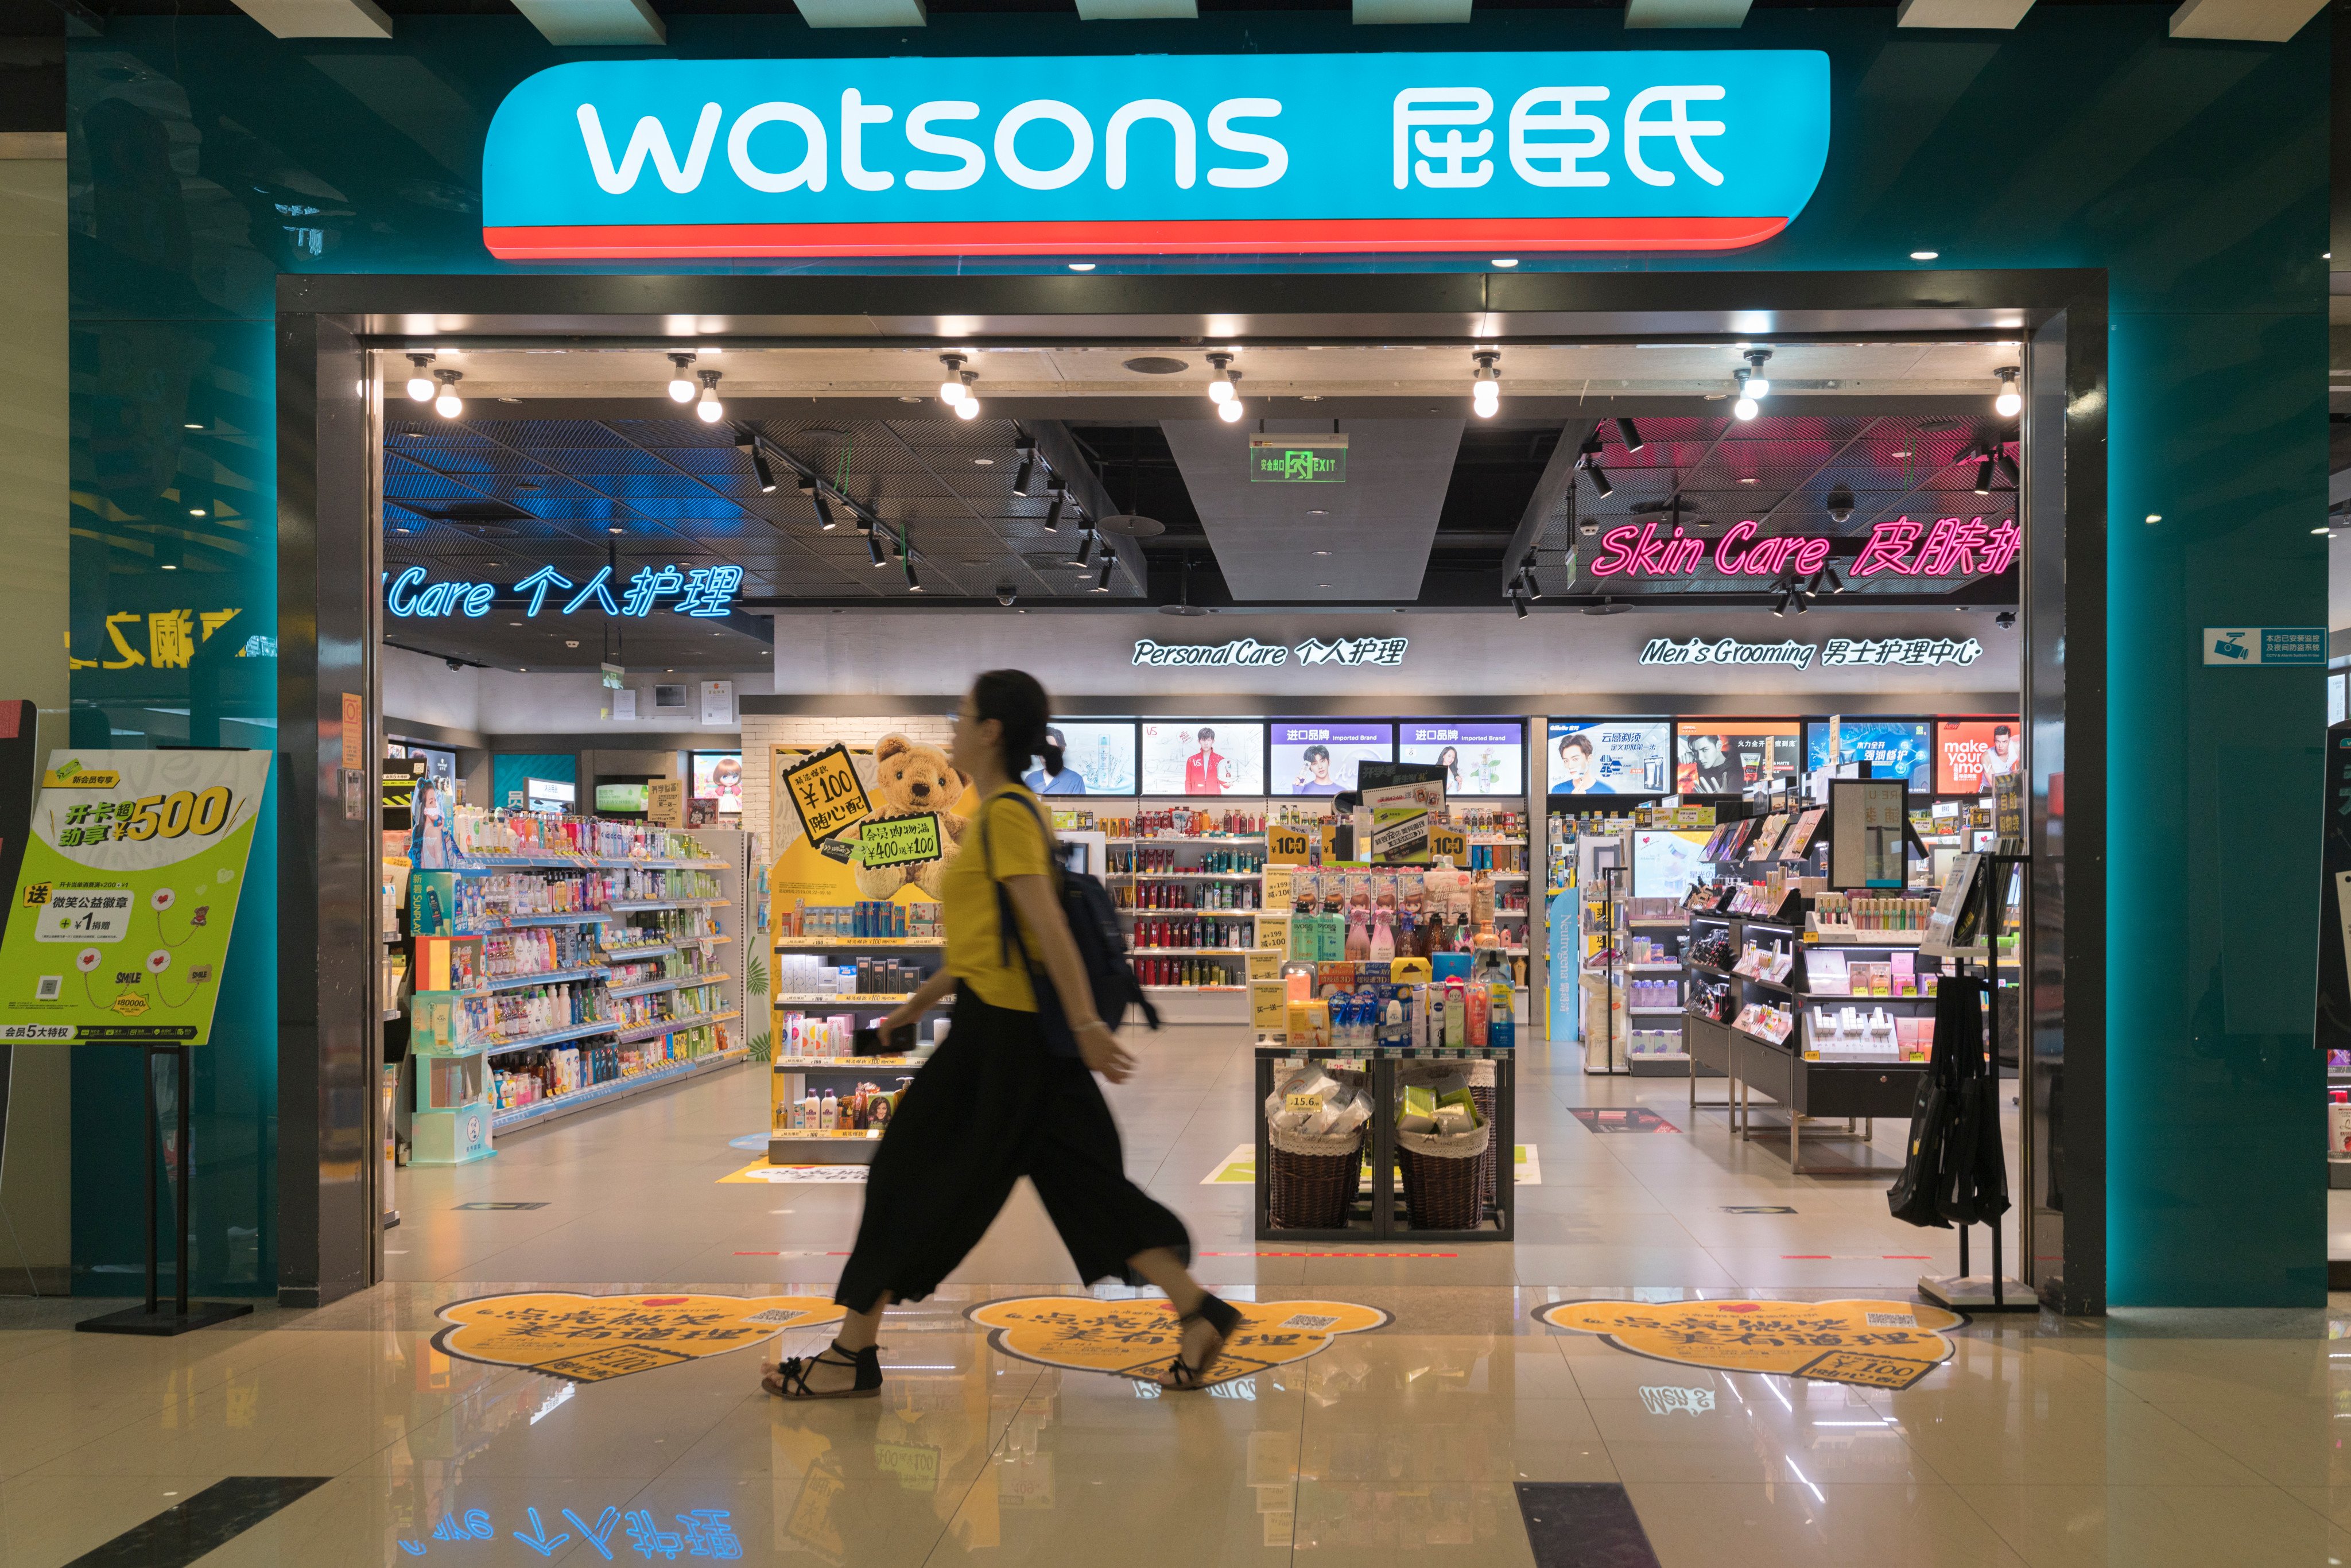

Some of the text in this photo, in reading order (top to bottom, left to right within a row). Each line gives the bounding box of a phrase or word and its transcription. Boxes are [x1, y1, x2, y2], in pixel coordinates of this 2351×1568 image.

[576, 87, 1289, 195] watsons
[1394, 85, 1726, 189] 屈臣氏
[1261, 459, 1284, 471] 安全出口
[1314, 459, 1336, 471] EXIT
[1590, 520, 1830, 577] Skin Care
[389, 565, 495, 618] Care
[514, 565, 744, 618] 个人护理
[1134, 639, 1286, 665] Personal Care
[1295, 638, 1407, 665] 个人护理
[1644, 639, 1815, 669] Men's Grooming
[1824, 639, 1983, 665] 男士护理中心
[1146, 727, 1157, 736] VS
[1287, 729, 1329, 741] 进口品牌
[1415, 729, 1458, 741] 进口品牌
[1601, 732, 1641, 742] 云感剃须
[1945, 739, 1988, 752] make
[1864, 750, 1908, 760] 强润修护
[1948, 753, 1981, 766] your
[72, 775, 113, 784] 新会员专享
[794, 766, 828, 786] 精选爆款
[799, 770, 852, 809] ¥100
[2001, 791, 2018, 811] 自助
[809, 796, 865, 833] 随心配
[1401, 820, 1426, 834] 美有道理
[2000, 814, 2020, 832] 购物袋
[866, 822, 930, 841] 会员购物满
[27, 886, 47, 905] 送
[1438, 885, 1461, 893] Amino
[53, 896, 128, 908] 微笑公益徽章
[1434, 892, 1462, 901] Mason
[413, 895, 422, 933] SUNPLAY
[1261, 938, 1285, 947] 减¥100
[1557, 914, 1572, 981] Neutrogena
[115, 972, 142, 984] SMILE
[192, 971, 207, 979] SMILE
[1256, 1004, 1283, 1013] 买一送一
[6, 1026, 68, 1038] 会员5大特权
